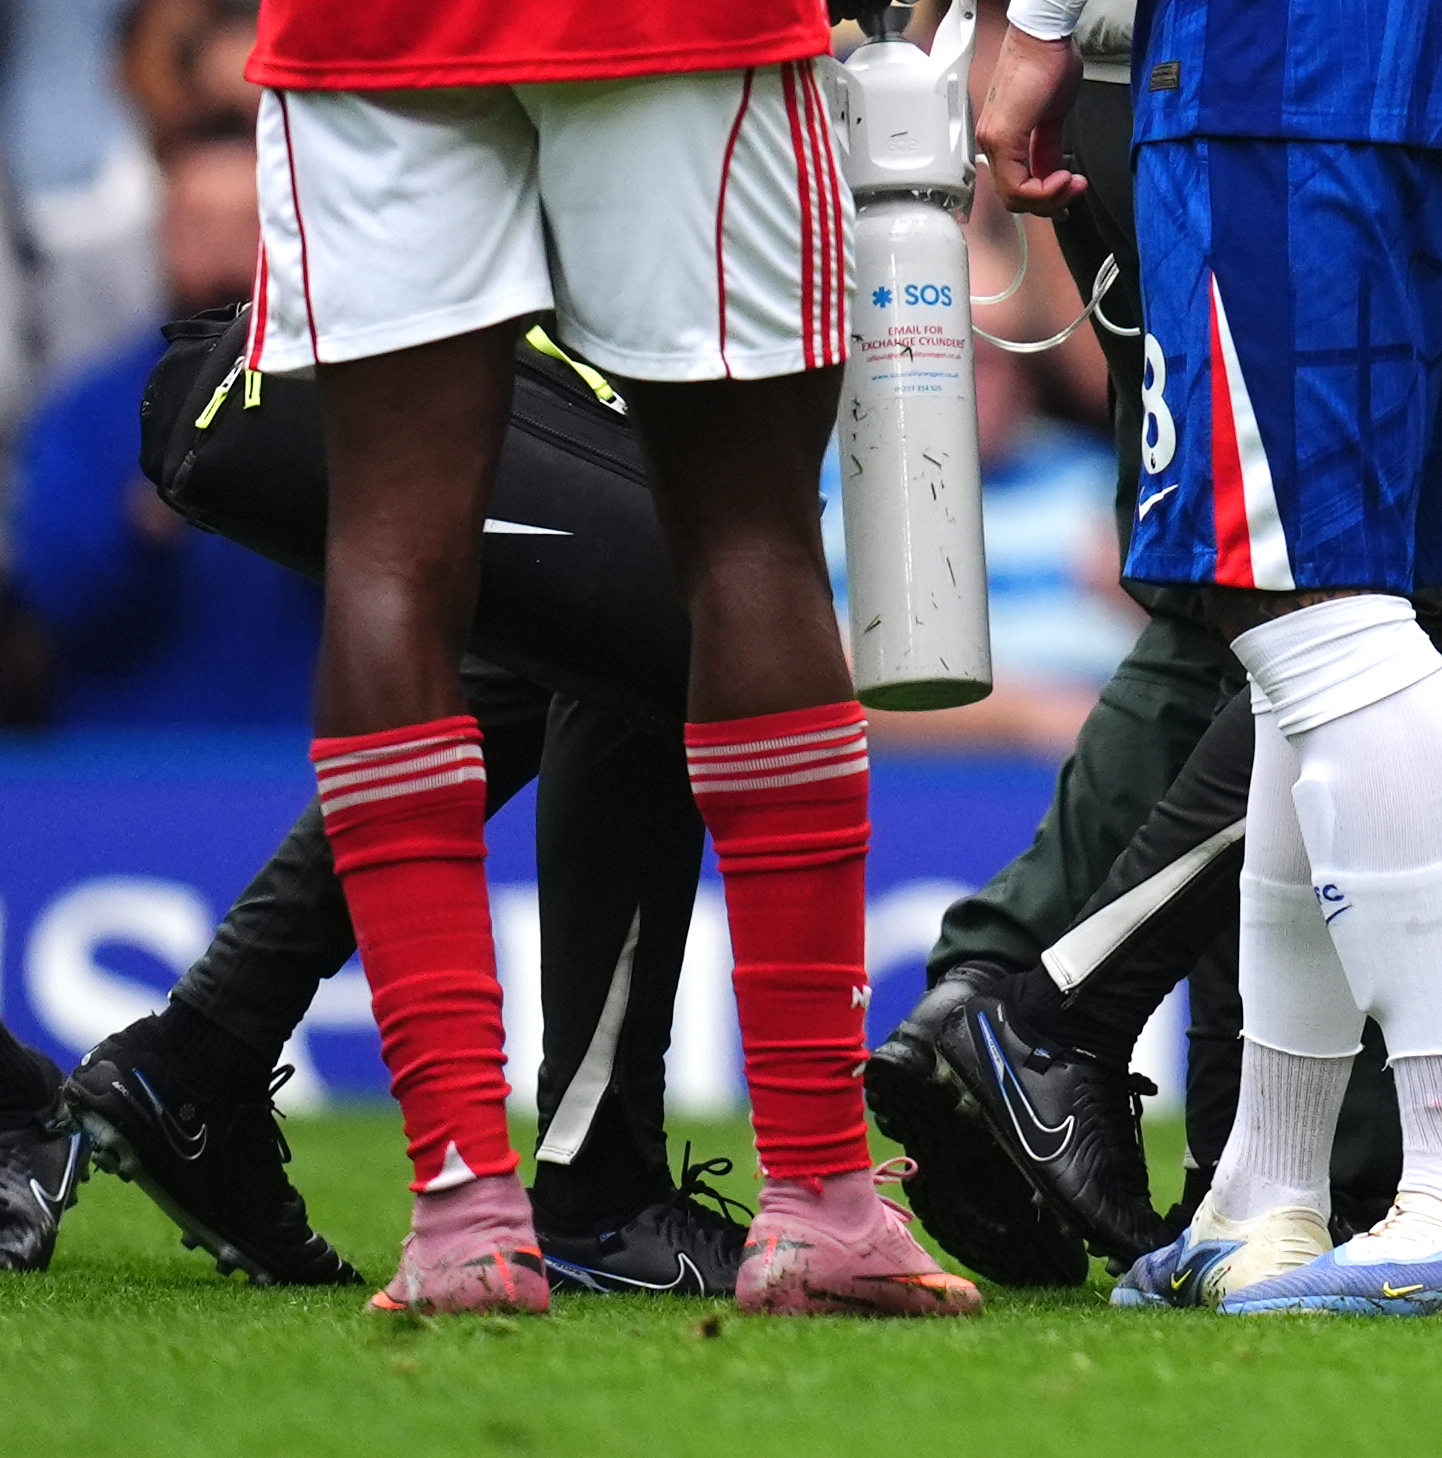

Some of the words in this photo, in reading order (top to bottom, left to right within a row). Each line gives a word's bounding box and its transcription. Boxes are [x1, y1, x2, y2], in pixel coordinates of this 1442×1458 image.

[904, 284, 953, 307] SOS
[888, 326, 921, 335] EMAIL
[924, 326, 943, 335] FOR
[862, 337, 916, 351] EXCHANGE
[1142, 333, 1176, 474] 8
